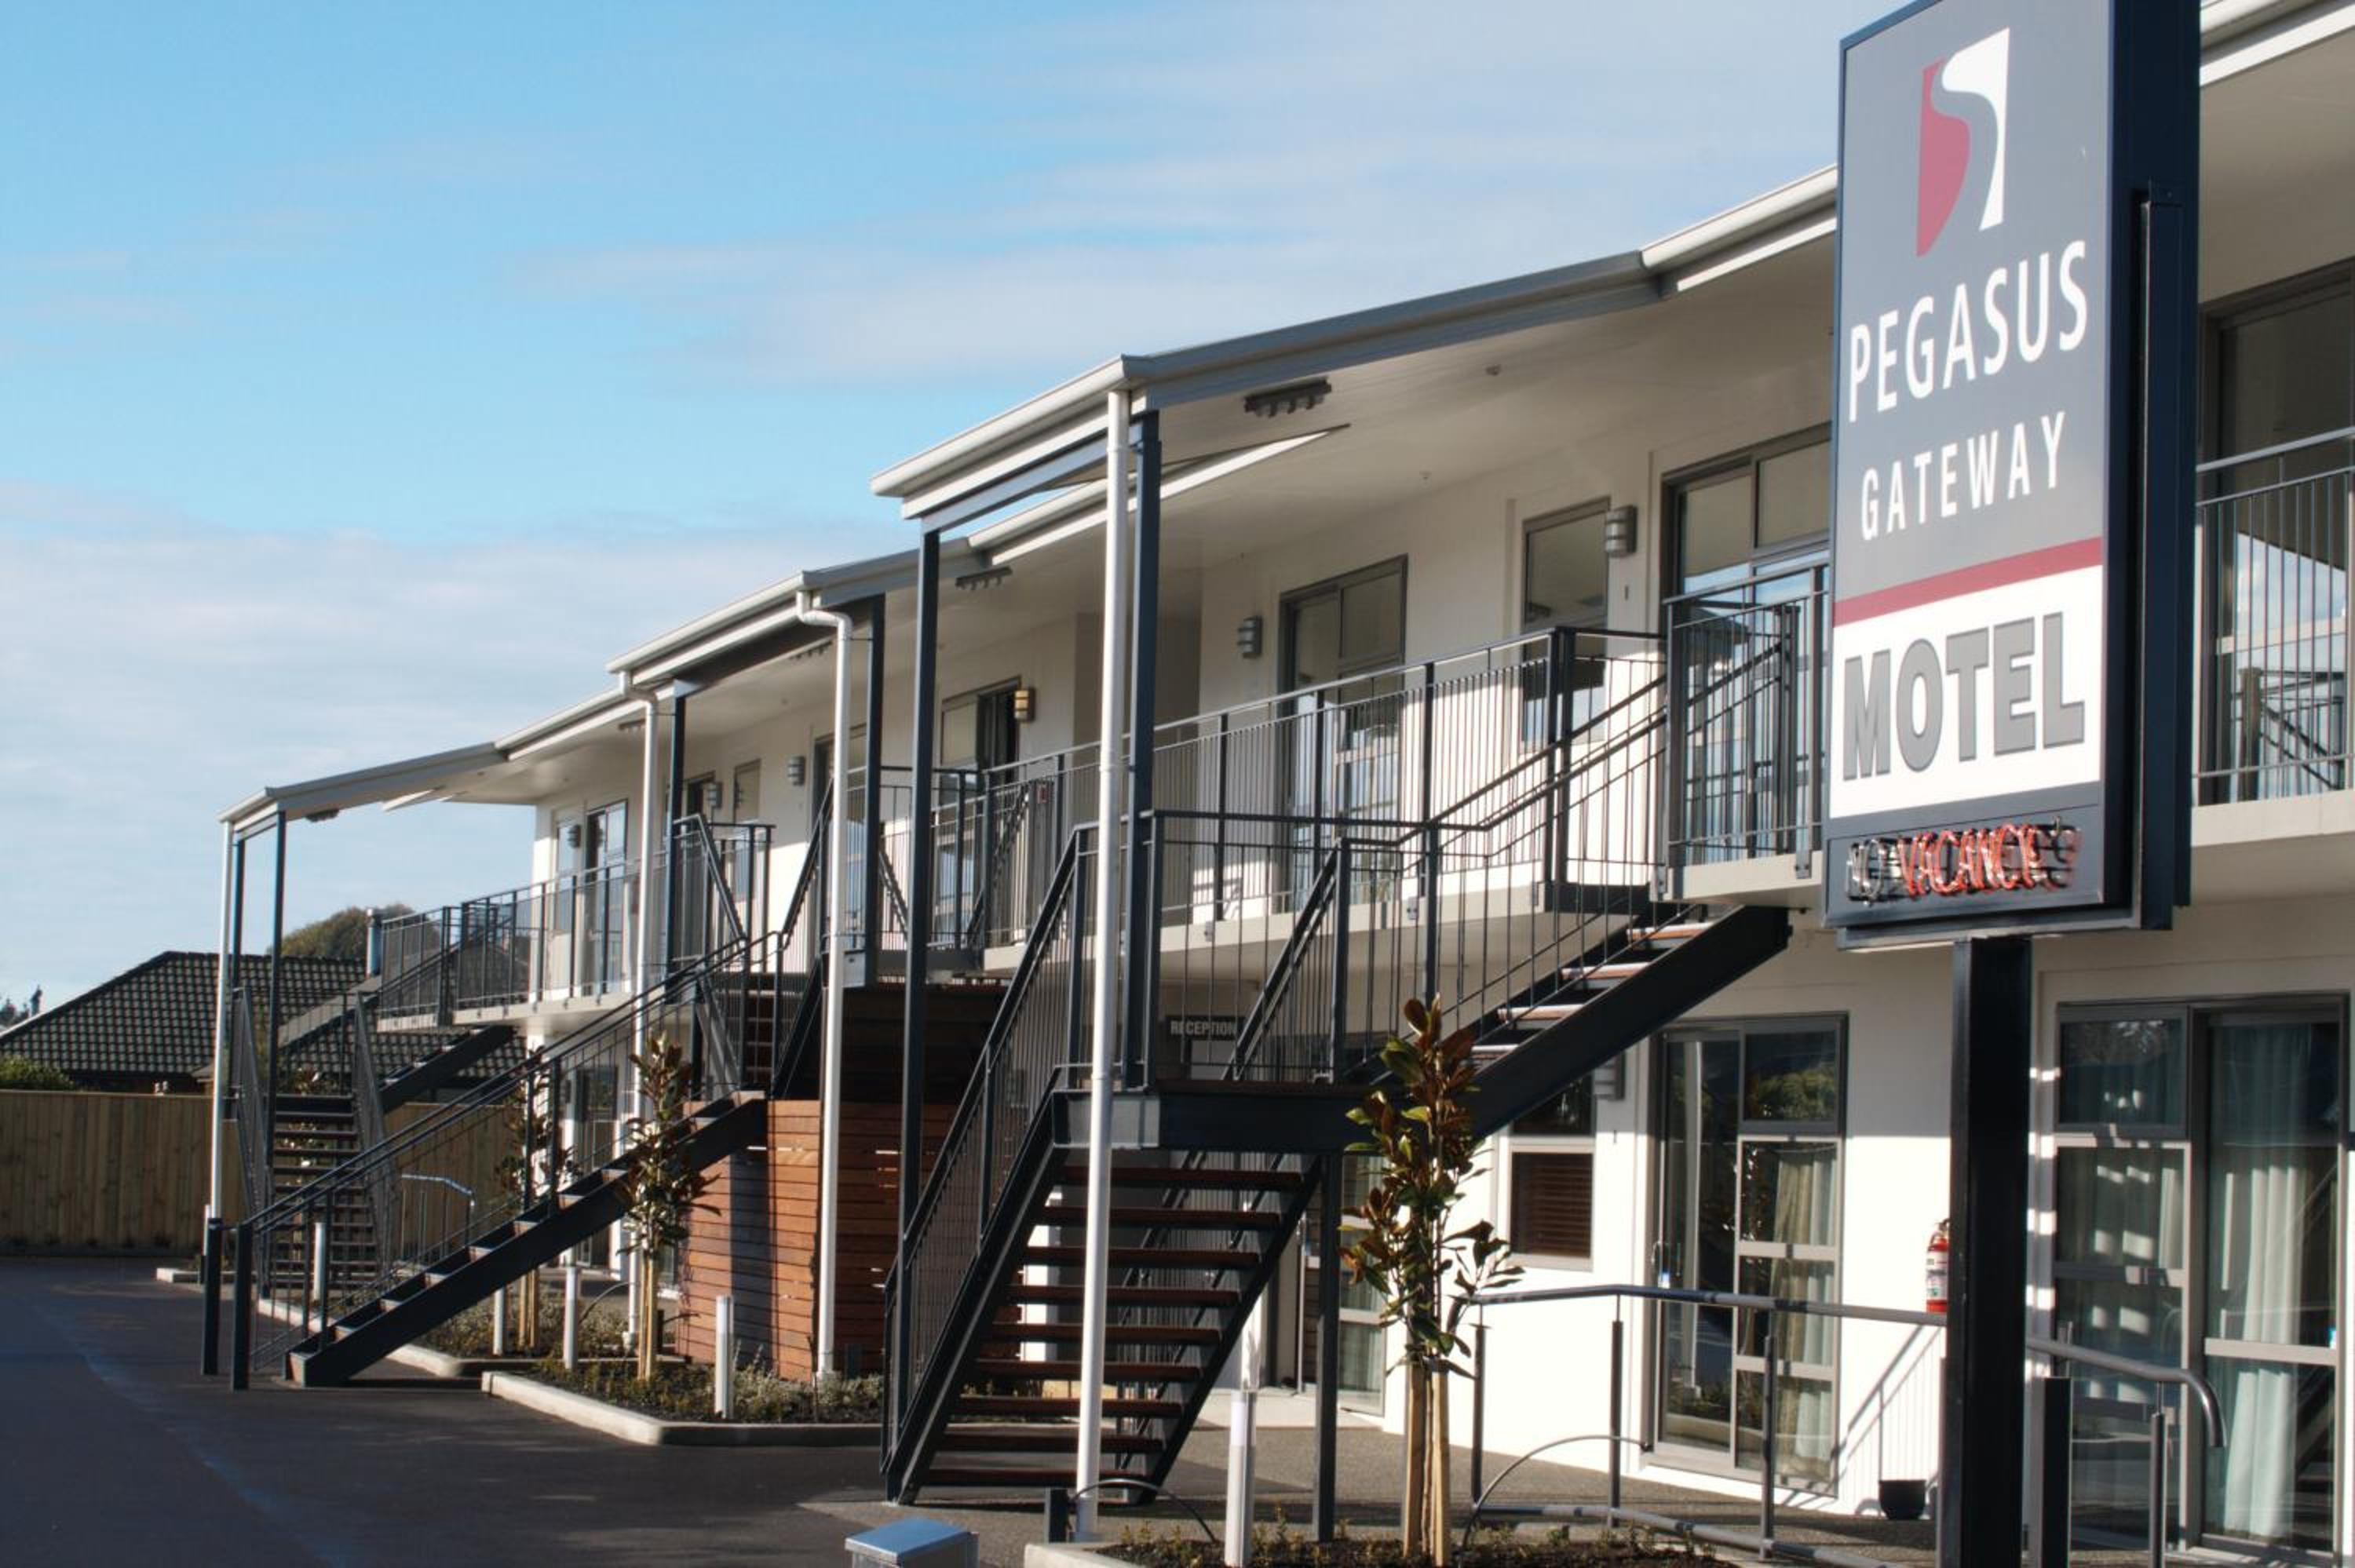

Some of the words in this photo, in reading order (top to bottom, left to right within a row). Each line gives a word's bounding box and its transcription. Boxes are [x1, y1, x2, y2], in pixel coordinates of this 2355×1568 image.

[1849, 239, 2088, 422] PEGASUS
[1860, 411, 2065, 541] GATEWAY
[1842, 611, 2085, 781] MOTEL
[1170, 1020, 1238, 1036] RECEPTION
